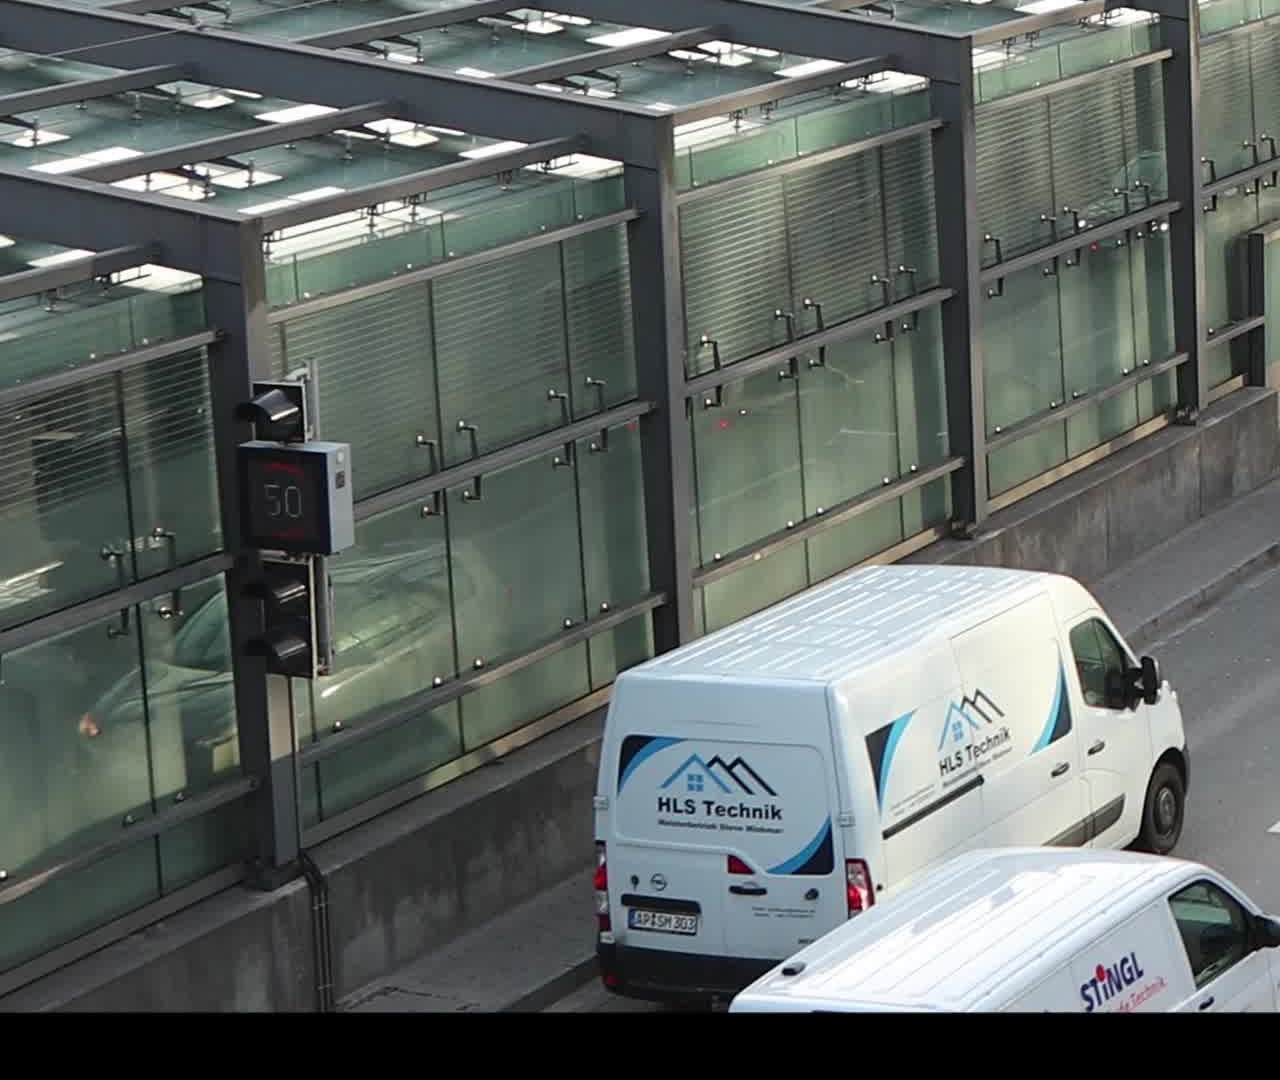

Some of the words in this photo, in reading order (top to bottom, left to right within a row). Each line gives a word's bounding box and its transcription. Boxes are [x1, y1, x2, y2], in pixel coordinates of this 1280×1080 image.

[263, 483, 302, 518] 50
[937, 750, 964, 776] HLS
[965, 726, 1010, 762] Technik
[658, 796, 696, 815] HLS
[702, 800, 783, 821] Technik
